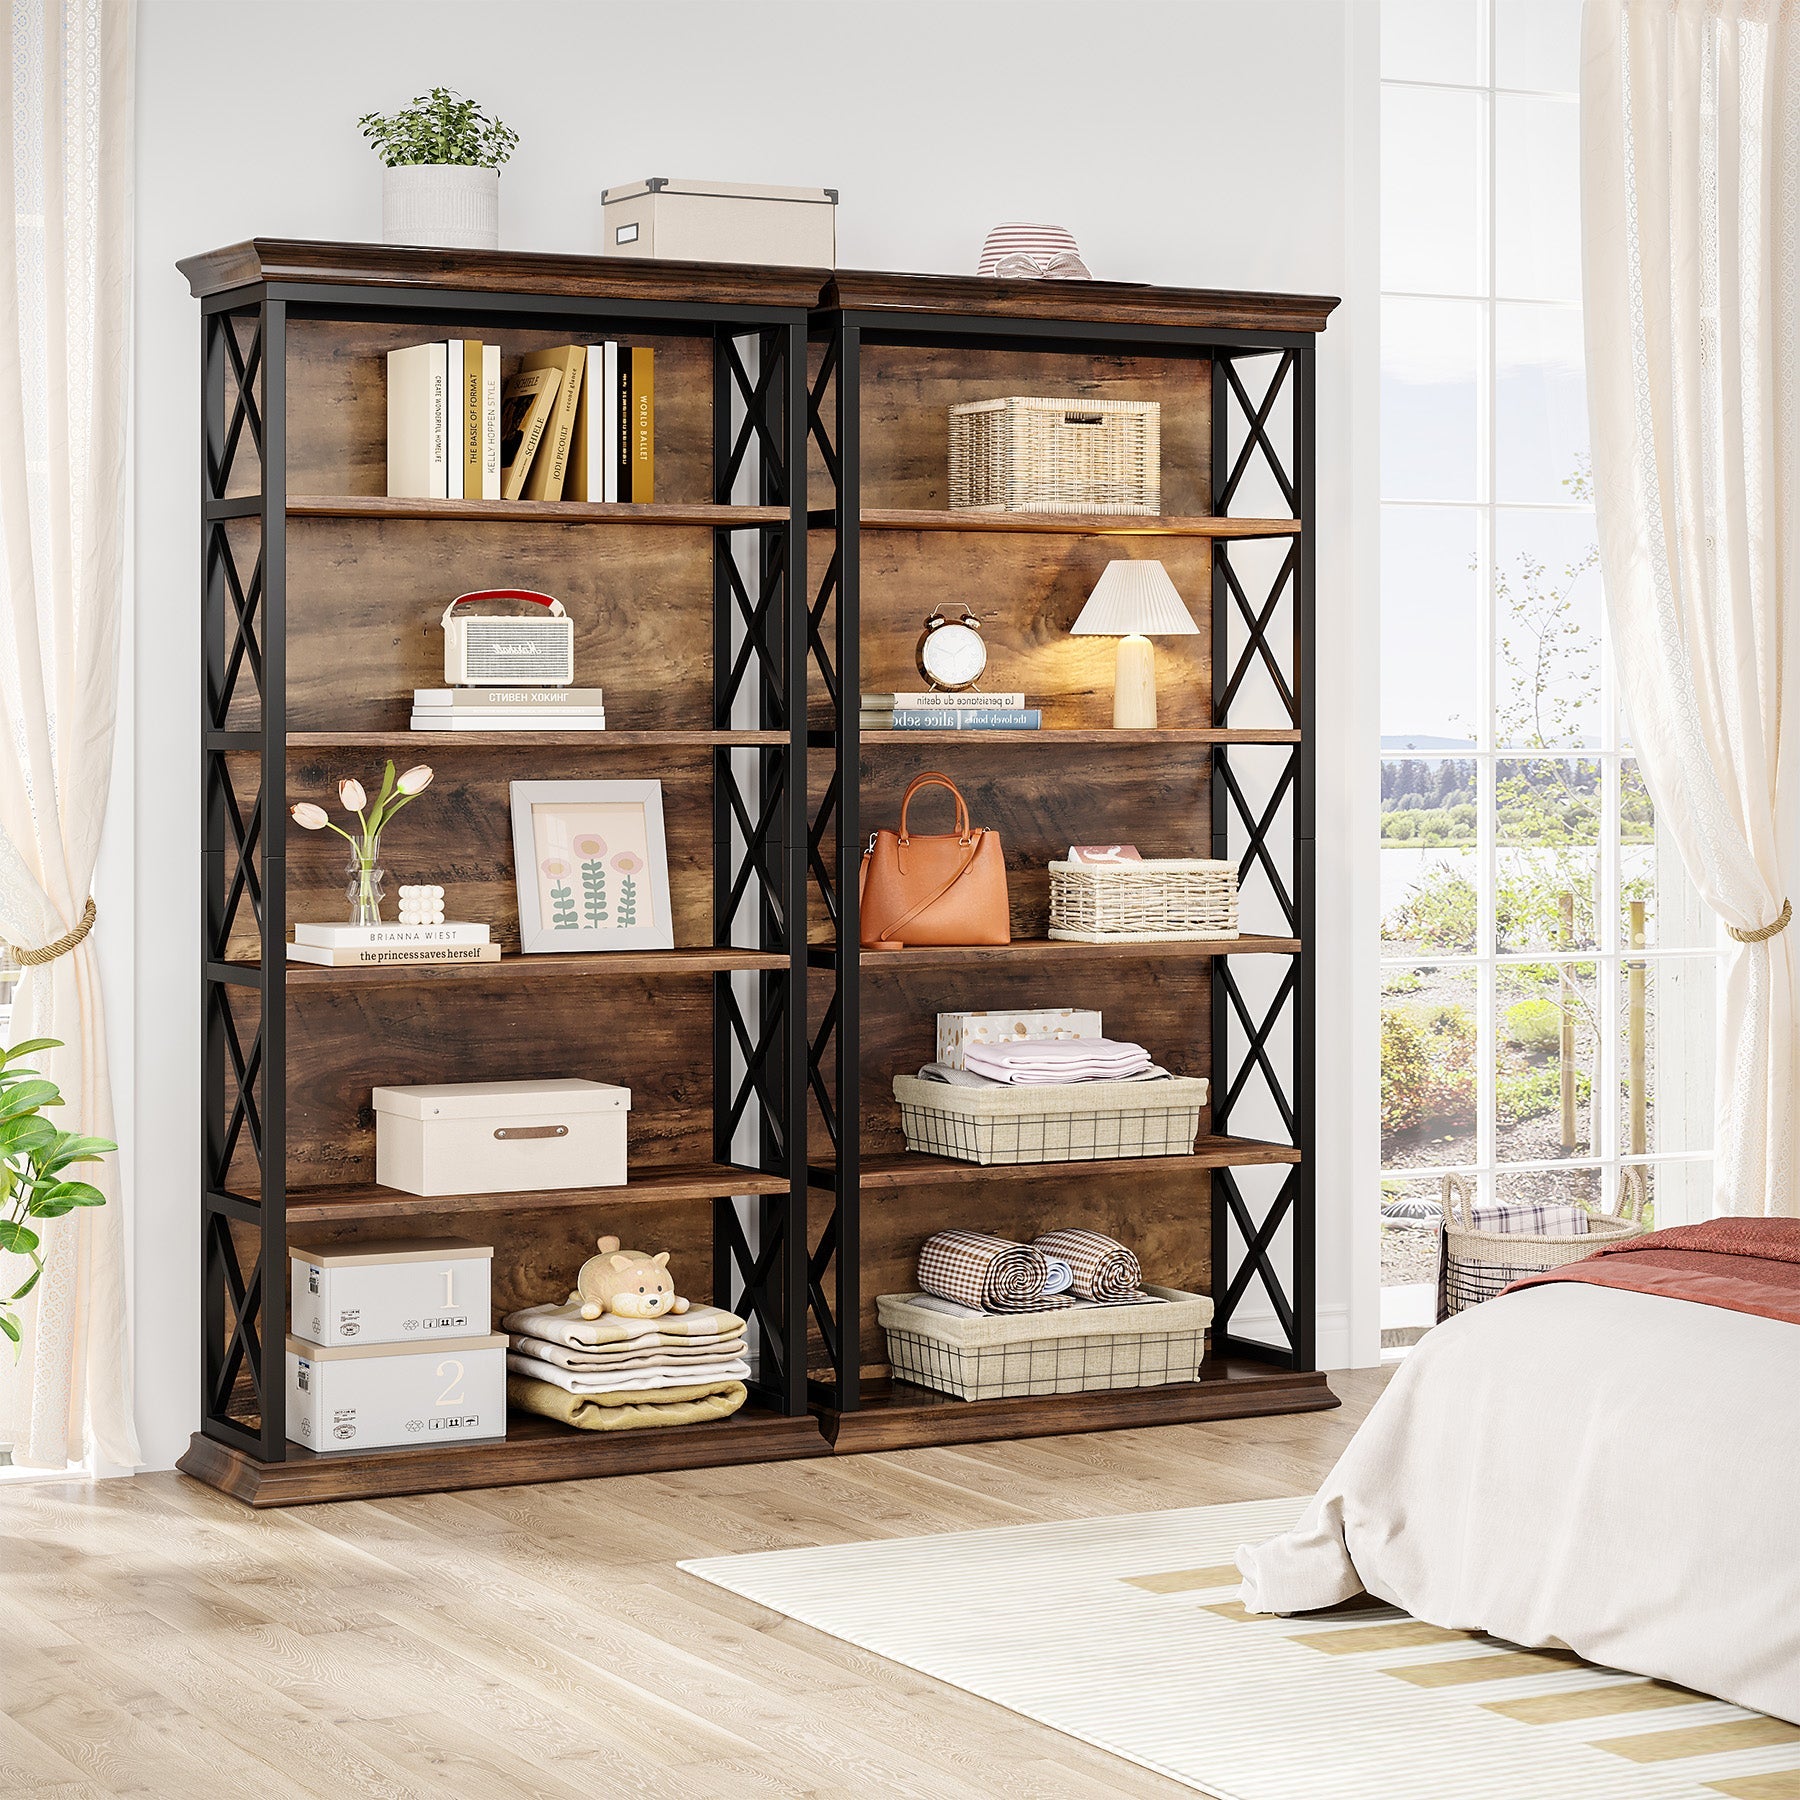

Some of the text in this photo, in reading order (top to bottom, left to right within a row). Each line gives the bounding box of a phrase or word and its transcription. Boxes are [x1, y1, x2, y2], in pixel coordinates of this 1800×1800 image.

[565, 368, 577, 412] second glance
[434, 375, 442, 463] CREATE WONDERFUL HOMELIFE
[470, 374, 478, 464] THE BASIC OF FORMAT
[487, 380, 496, 474] KELLY HOPPEN STYLE
[525, 416, 545, 457] SCHIELE
[640, 395, 648, 461] WORLD BALLET
[553, 425, 568, 481] JODI PICOULT
[489, 693, 570, 702] СТИВЕН ХОКИНГ
[370, 931, 457, 942] BRIANNA WIEST
[439, 1268, 460, 1309] 1
[435, 1359, 465, 1406] 2
